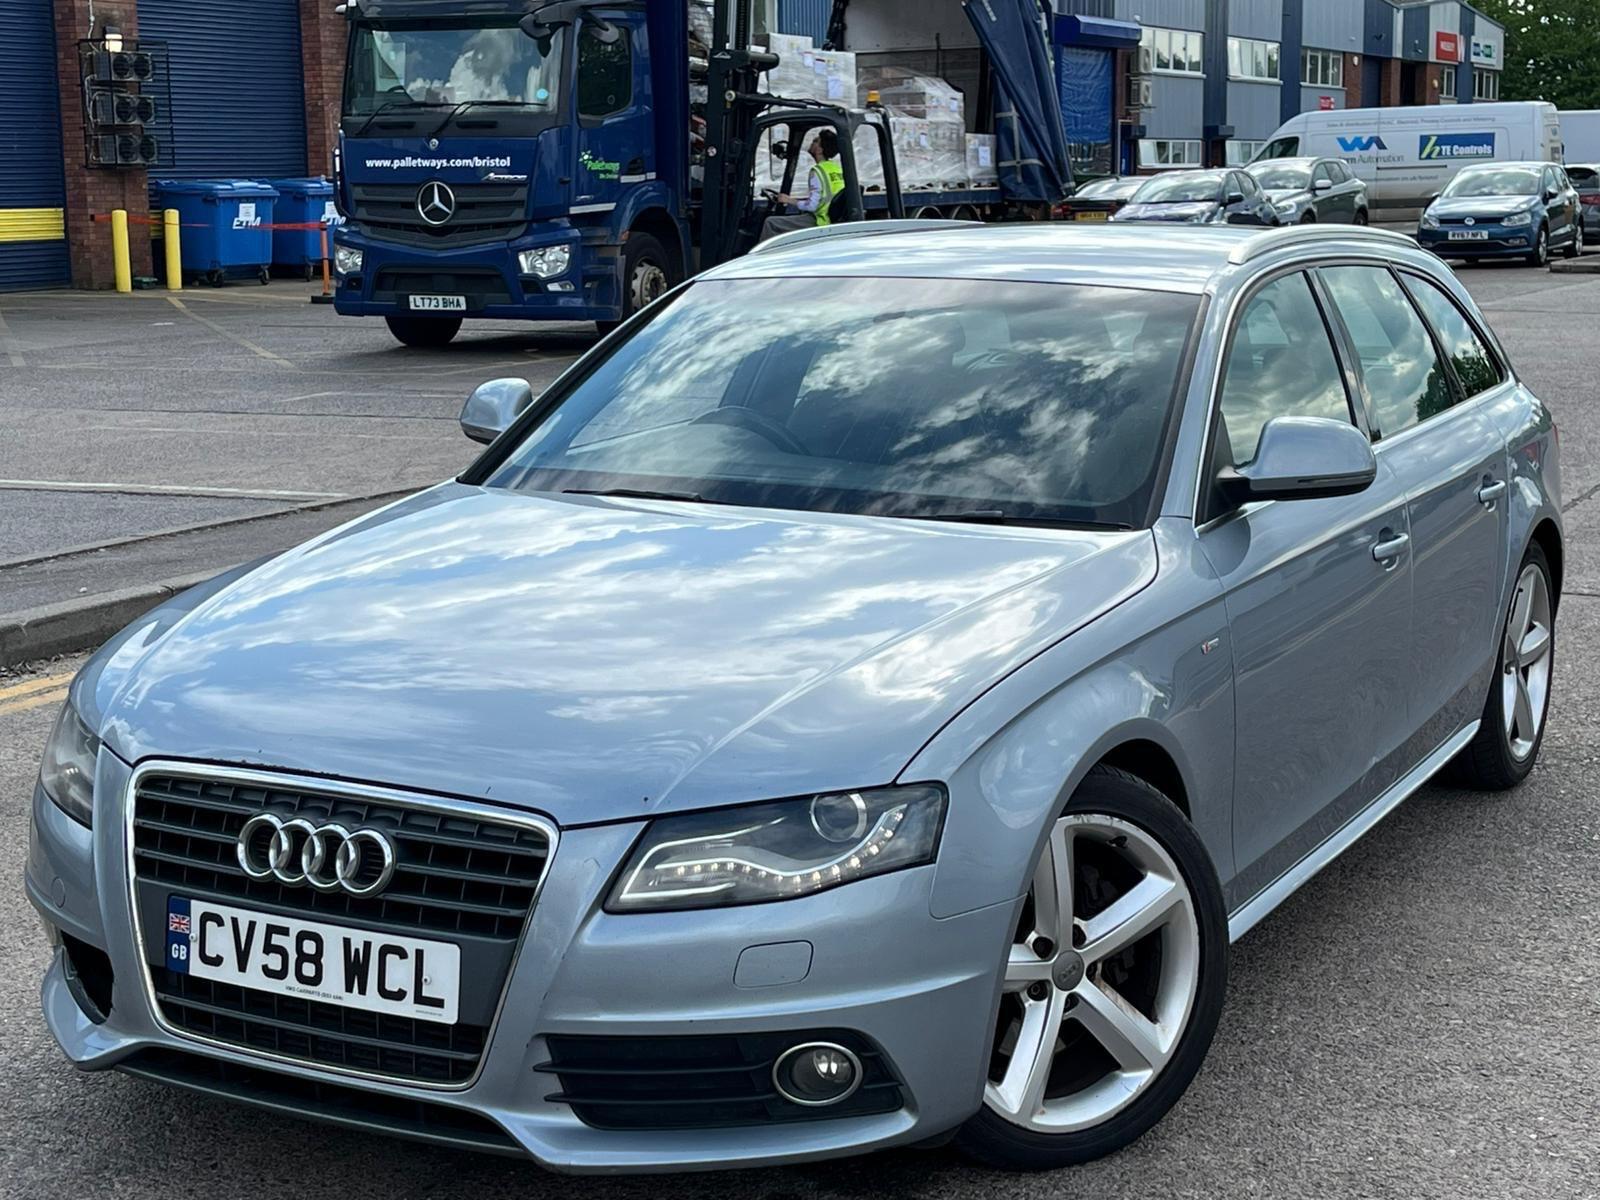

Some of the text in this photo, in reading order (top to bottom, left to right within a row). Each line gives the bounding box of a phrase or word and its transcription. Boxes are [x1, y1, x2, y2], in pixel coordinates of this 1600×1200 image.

[1453, 144, 1492, 156] Controls
[365, 156, 511, 170] www.palletways.com/bristol
[413, 297, 462, 308] LT73 BHA
[171, 943, 187, 960] GB
[199, 910, 445, 1009] CV58 WCL
